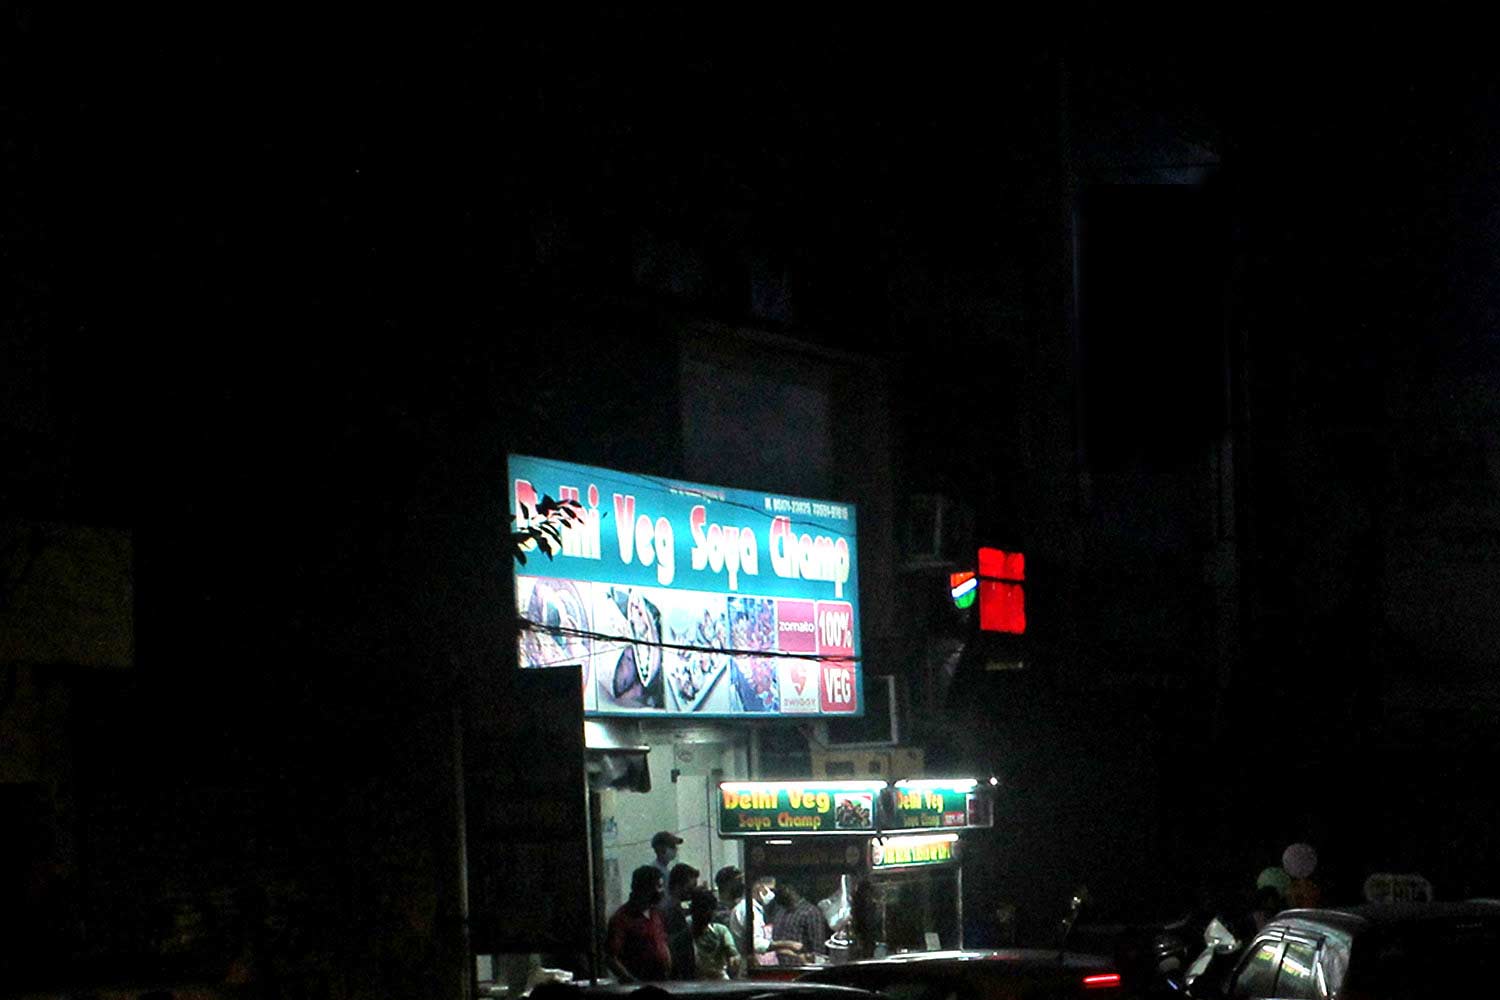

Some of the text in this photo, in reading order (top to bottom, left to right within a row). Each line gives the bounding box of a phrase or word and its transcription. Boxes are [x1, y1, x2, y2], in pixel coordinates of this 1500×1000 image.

[613, 493, 675, 586] Veg
[690, 505, 758, 591] Soya
[770, 515, 849, 598] Champ
[779, 611, 852, 648] zomato 100%
[823, 668, 851, 703] VEG
[723, 789, 830, 813] Delhi Veg
[739, 812, 821, 830] Soya Champ
